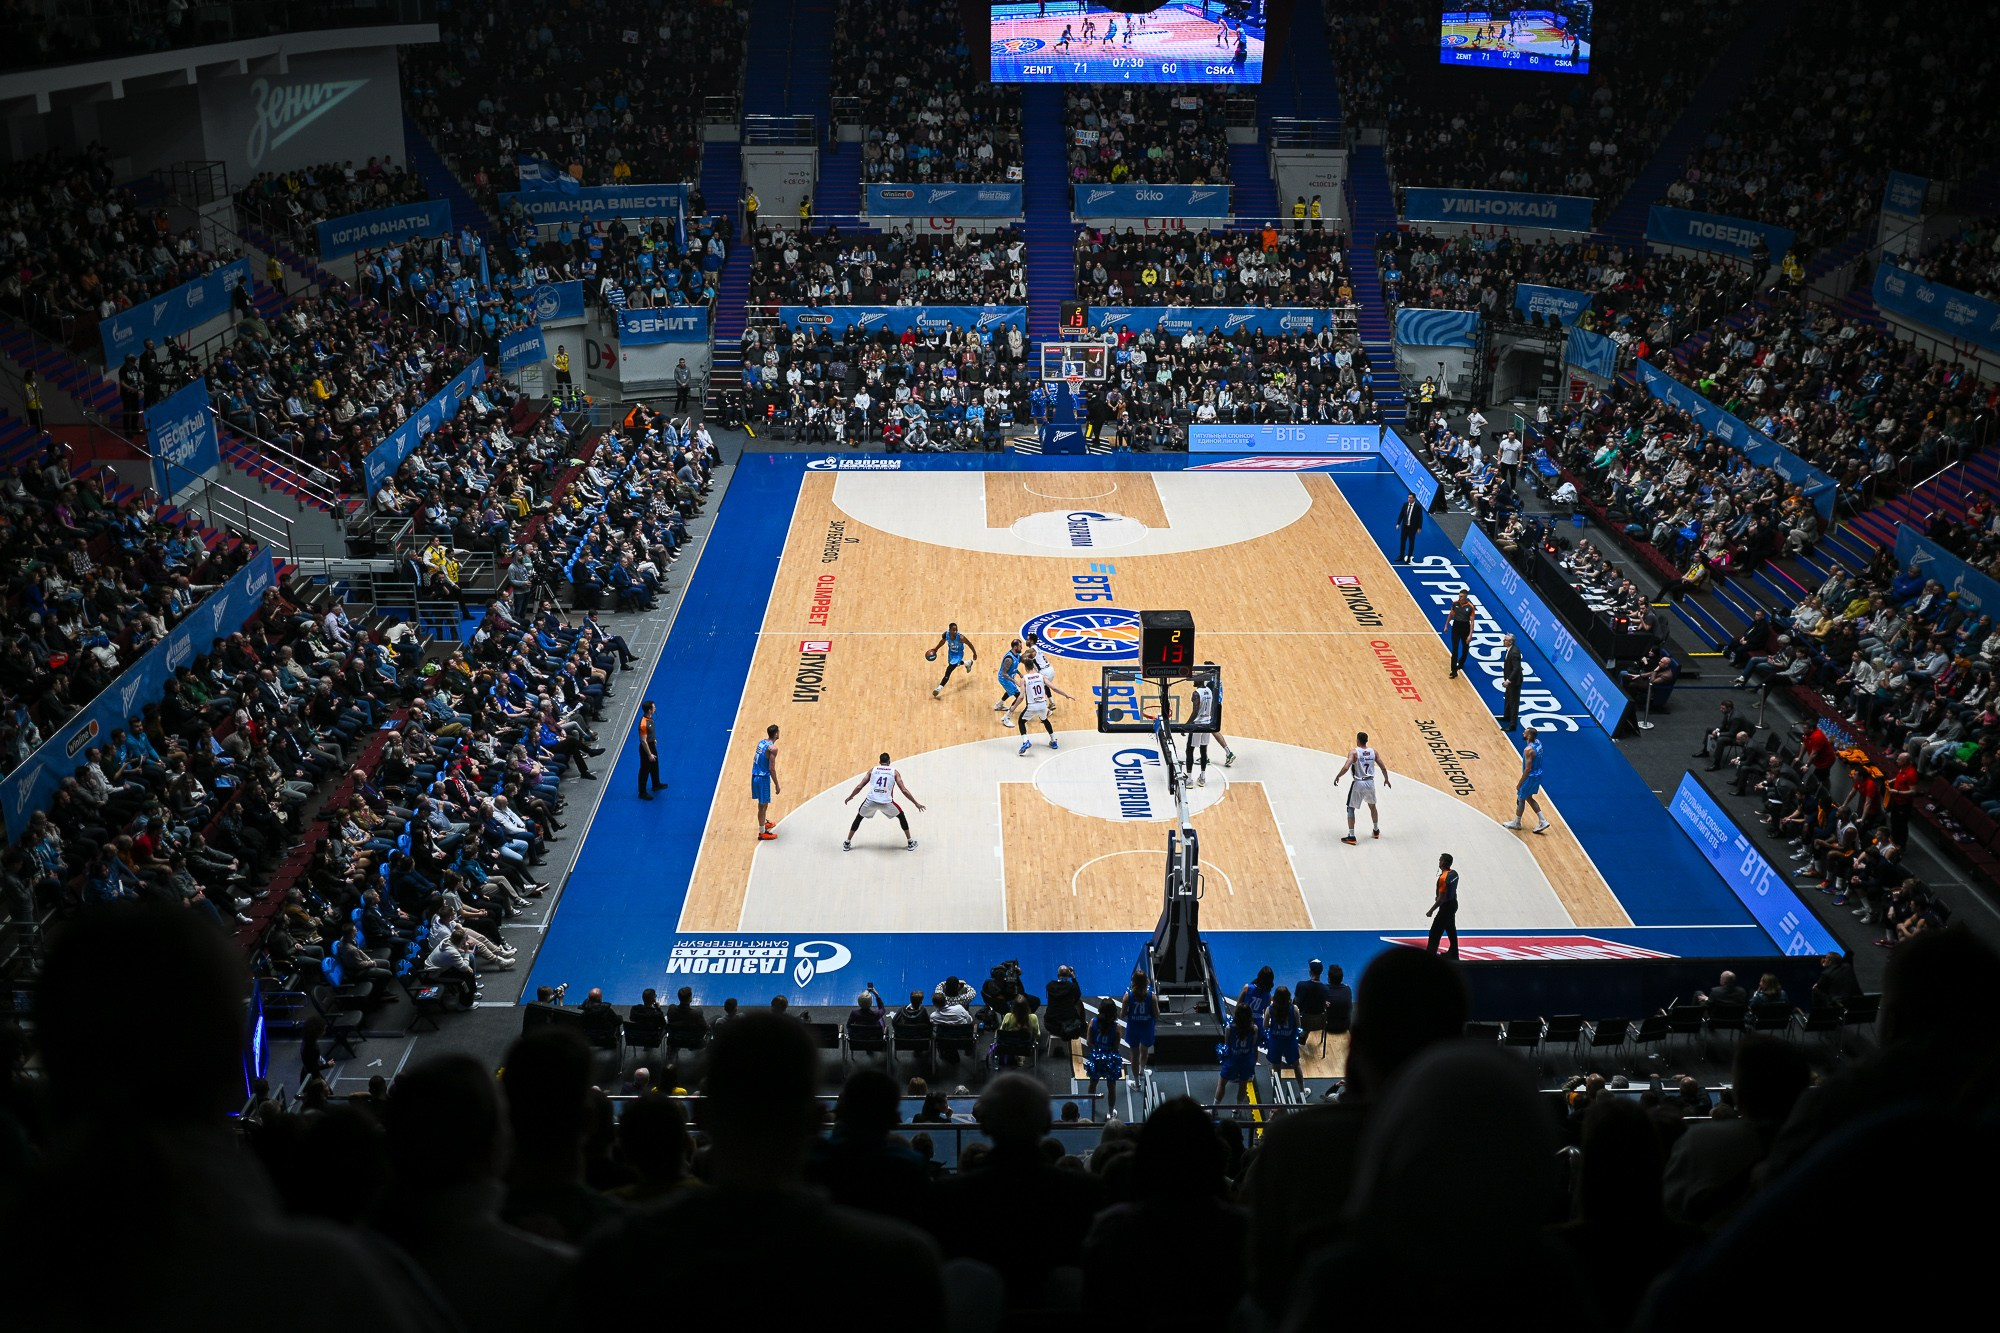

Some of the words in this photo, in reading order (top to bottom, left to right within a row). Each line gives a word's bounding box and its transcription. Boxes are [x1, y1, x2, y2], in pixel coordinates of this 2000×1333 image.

[1456, 52, 1472, 61] ZENIT
[1482, 52, 1490, 61] 71
[1502, 51, 1521, 59] 07:30
[1530, 56, 1539, 64] 60
[1023, 65, 1054, 75] ZENIT
[1074, 62, 1088, 74] 71
[1113, 58, 1144, 68] 07:30
[1162, 63, 1177, 74] 60
[1206, 65, 1235, 75] CSKA
[1554, 59, 1573, 68] CSKA
[1124, 71, 1130, 80] 4
[522, 198, 606, 213] КОМАНДА
[607, 195, 678, 209] ВМЕСТЕ
[1442, 197, 1558, 219] УМНОЖАЙ
[331, 224, 370, 247] КОГДА
[369, 213, 431, 236] ФАНАТЫ
[1075, 307, 1082, 315] 2
[627, 317, 698, 334] ЗЕНИТ
[1070, 315, 1083, 327] 13
[518, 338, 540, 354] ИМЯ
[585, 338, 601, 371] D
[158, 410, 206, 457] ДЕСЯТЫЙ
[1276, 427, 1307, 441] ВТБ
[1340, 437, 1371, 451] ВТБ
[1408, 555, 1462, 579] ST
[1499, 563, 1521, 595] ВТБ
[1071, 575, 1113, 602] ВТБ
[808, 574, 836, 627] OLIMPBET
[1336, 584, 1384, 627] ЛУКОЙЛ
[1520, 611, 1542, 641] ВТБ
[1171, 630, 1181, 643] 2
[1553, 626, 1578, 662] ВТБ
[1087, 639, 1118, 651] 15
[1162, 644, 1184, 663] 13
[793, 652, 827, 703] ЛУКОЙЛ
[1149, 667, 1178, 676] Winline
[1370, 640, 1423, 702] OLIMPBET
[1032, 684, 1042, 695] 10
[1584, 685, 1610, 723] ВТБ
[1414, 718, 1476, 795] ЗАРУБЕЖНЕФТЬ
[1363, 762, 1371, 774] 7
[875, 776, 888, 787] 41
[1113, 766, 1153, 817] GAZPROM
[1681, 785, 1708, 817] ТИТУЛЬНЫЙ
[1705, 815, 1729, 843] СПОНСОР
[1679, 798, 1699, 825] ЕДИНОЙ
[1696, 819, 1711, 839] ЛИГИ
[1707, 834, 1719, 849] ВТБ
[1739, 847, 1777, 897] ВТБ
[673, 940, 790, 948] САНКТ-ПЕТЕРБУРГ
[665, 957, 787, 974] ГАЗПРОМ
[1133, 1001, 1145, 1014] 78
[1249, 996, 1263, 1010] 78
